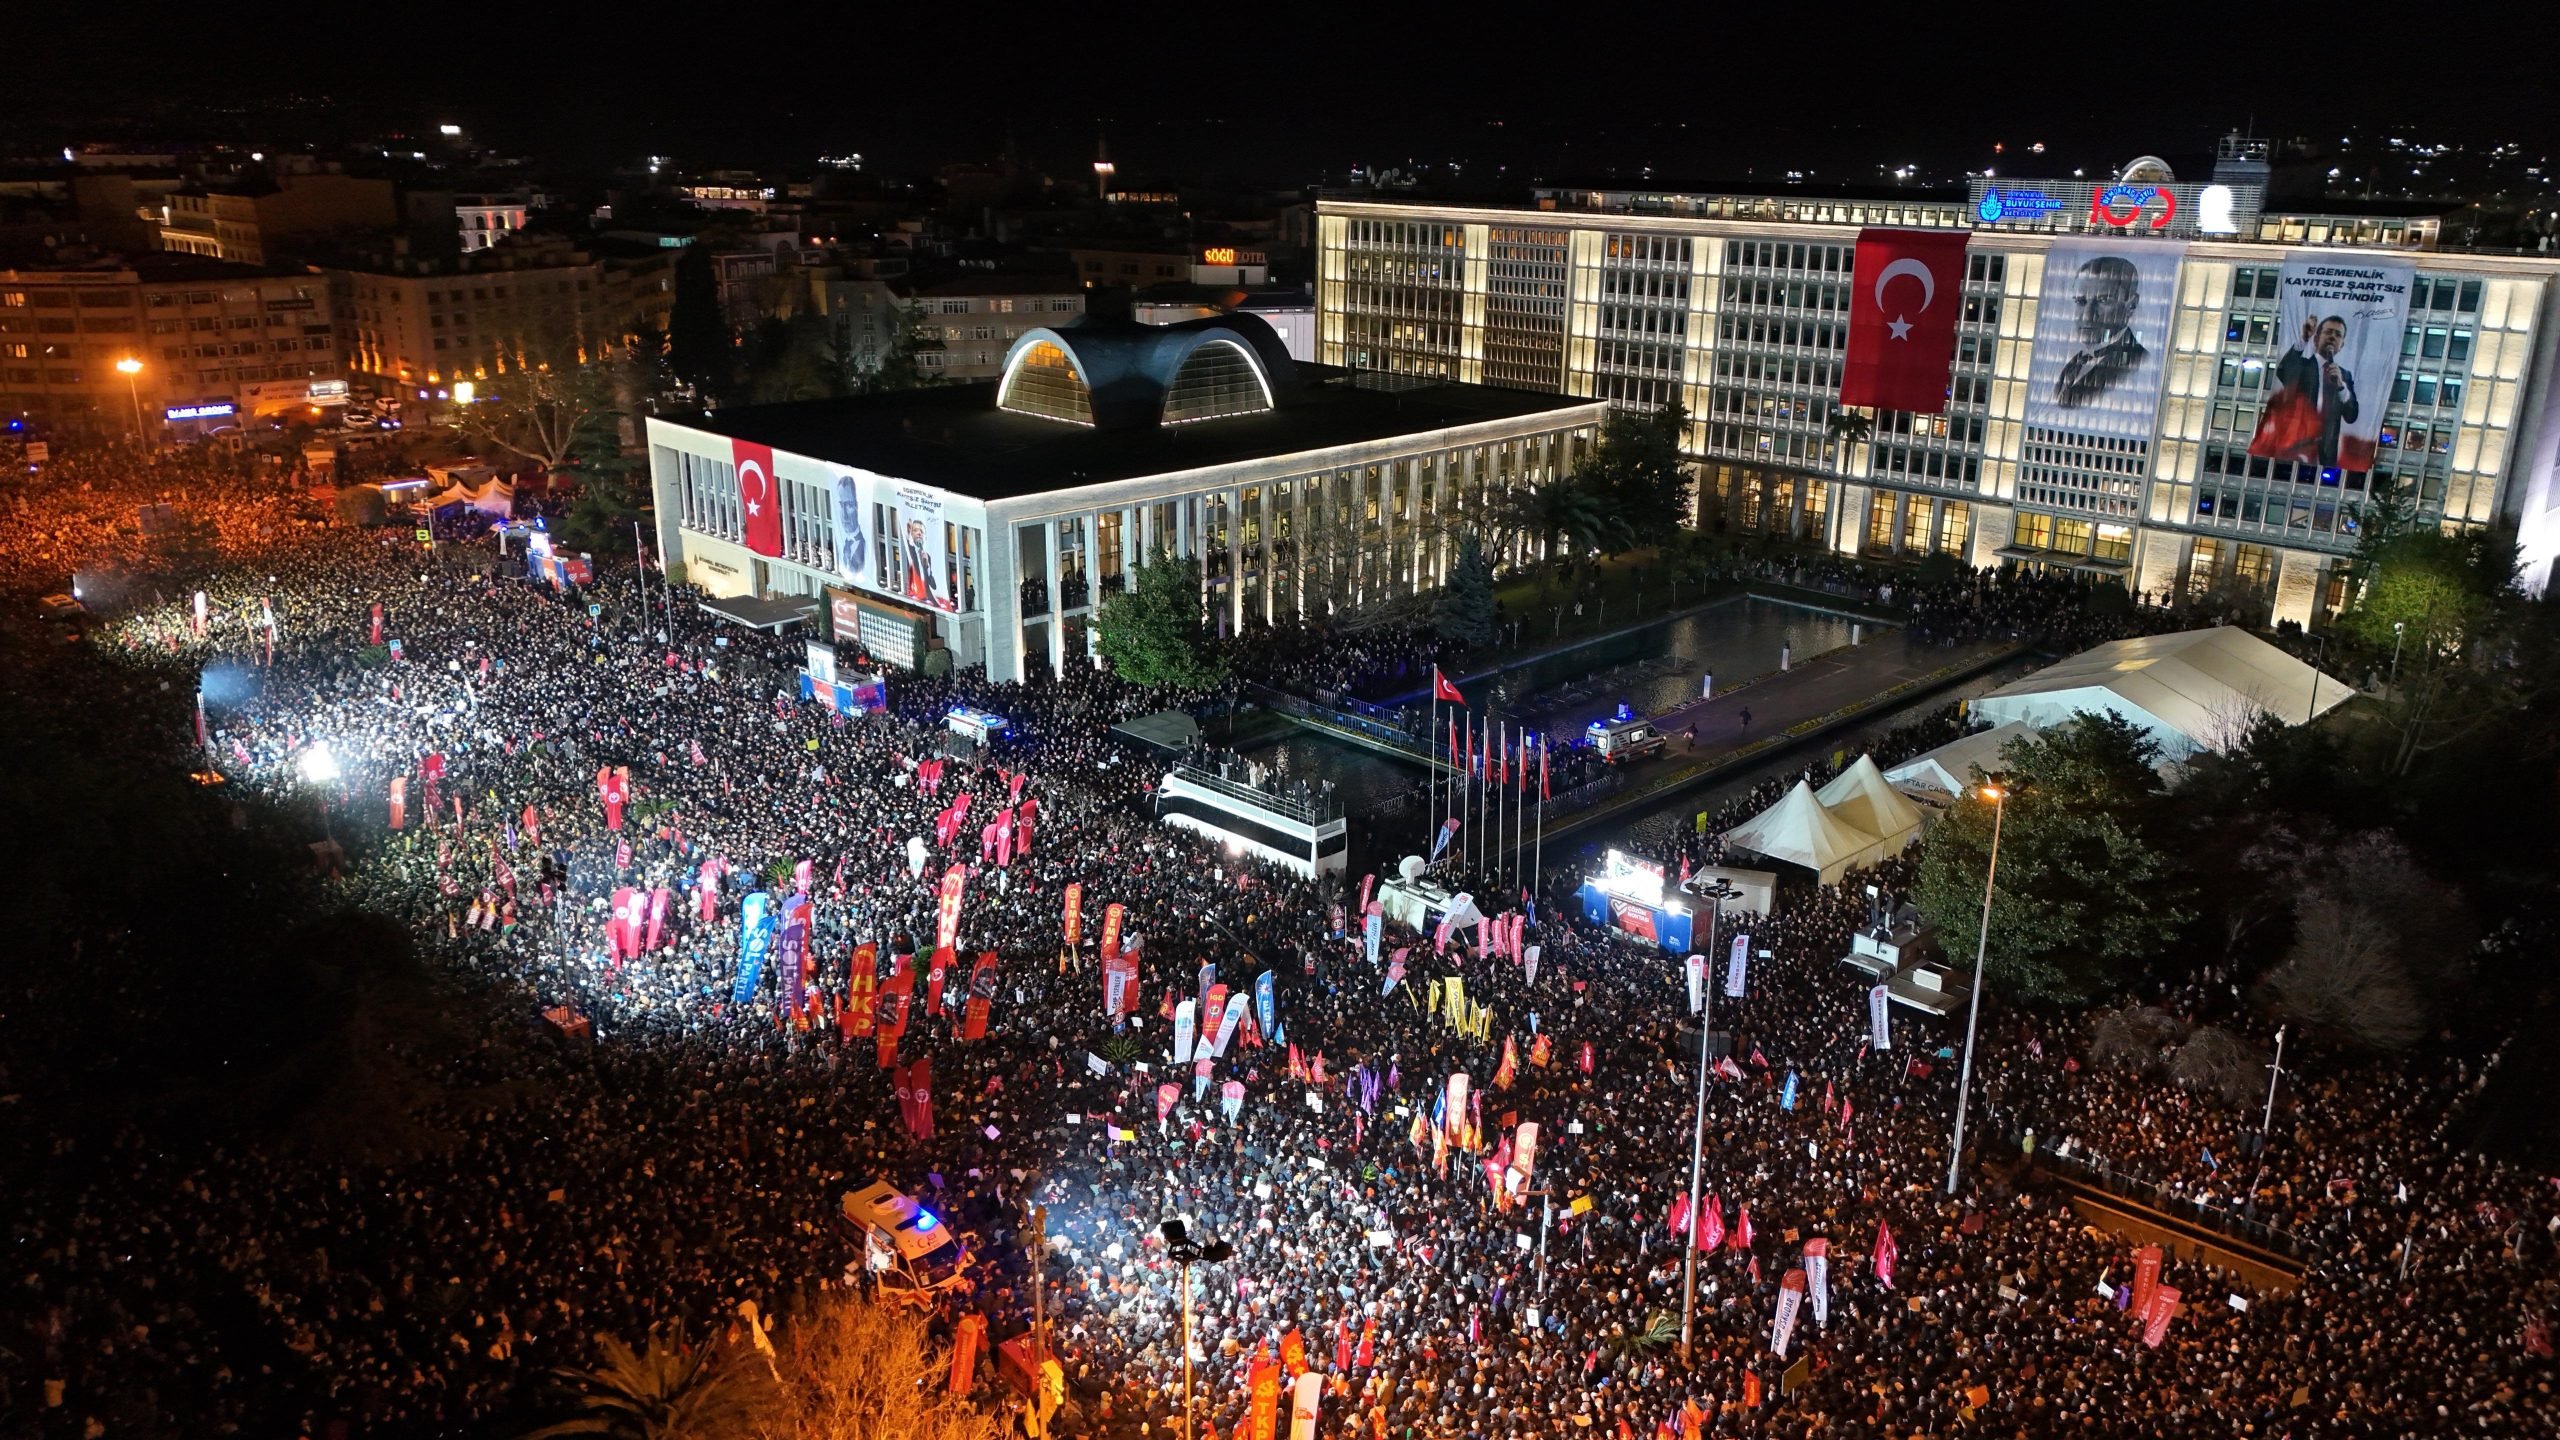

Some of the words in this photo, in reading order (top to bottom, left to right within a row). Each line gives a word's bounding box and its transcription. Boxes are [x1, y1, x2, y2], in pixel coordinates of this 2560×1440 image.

[2307, 267, 2384, 280] EGEMENLİK
[2285, 277, 2344, 289] KAYITSIZ
[2346, 281, 2405, 294] ŞARTSIZ
[2300, 288, 2385, 303] MİLLETİNDİR
[1903, 776, 1926, 789] İFTAR
[1068, 899, 1077, 938] EMEK
[851, 974, 874, 1036] HKP
[1255, 1402, 1271, 1440] TKP
